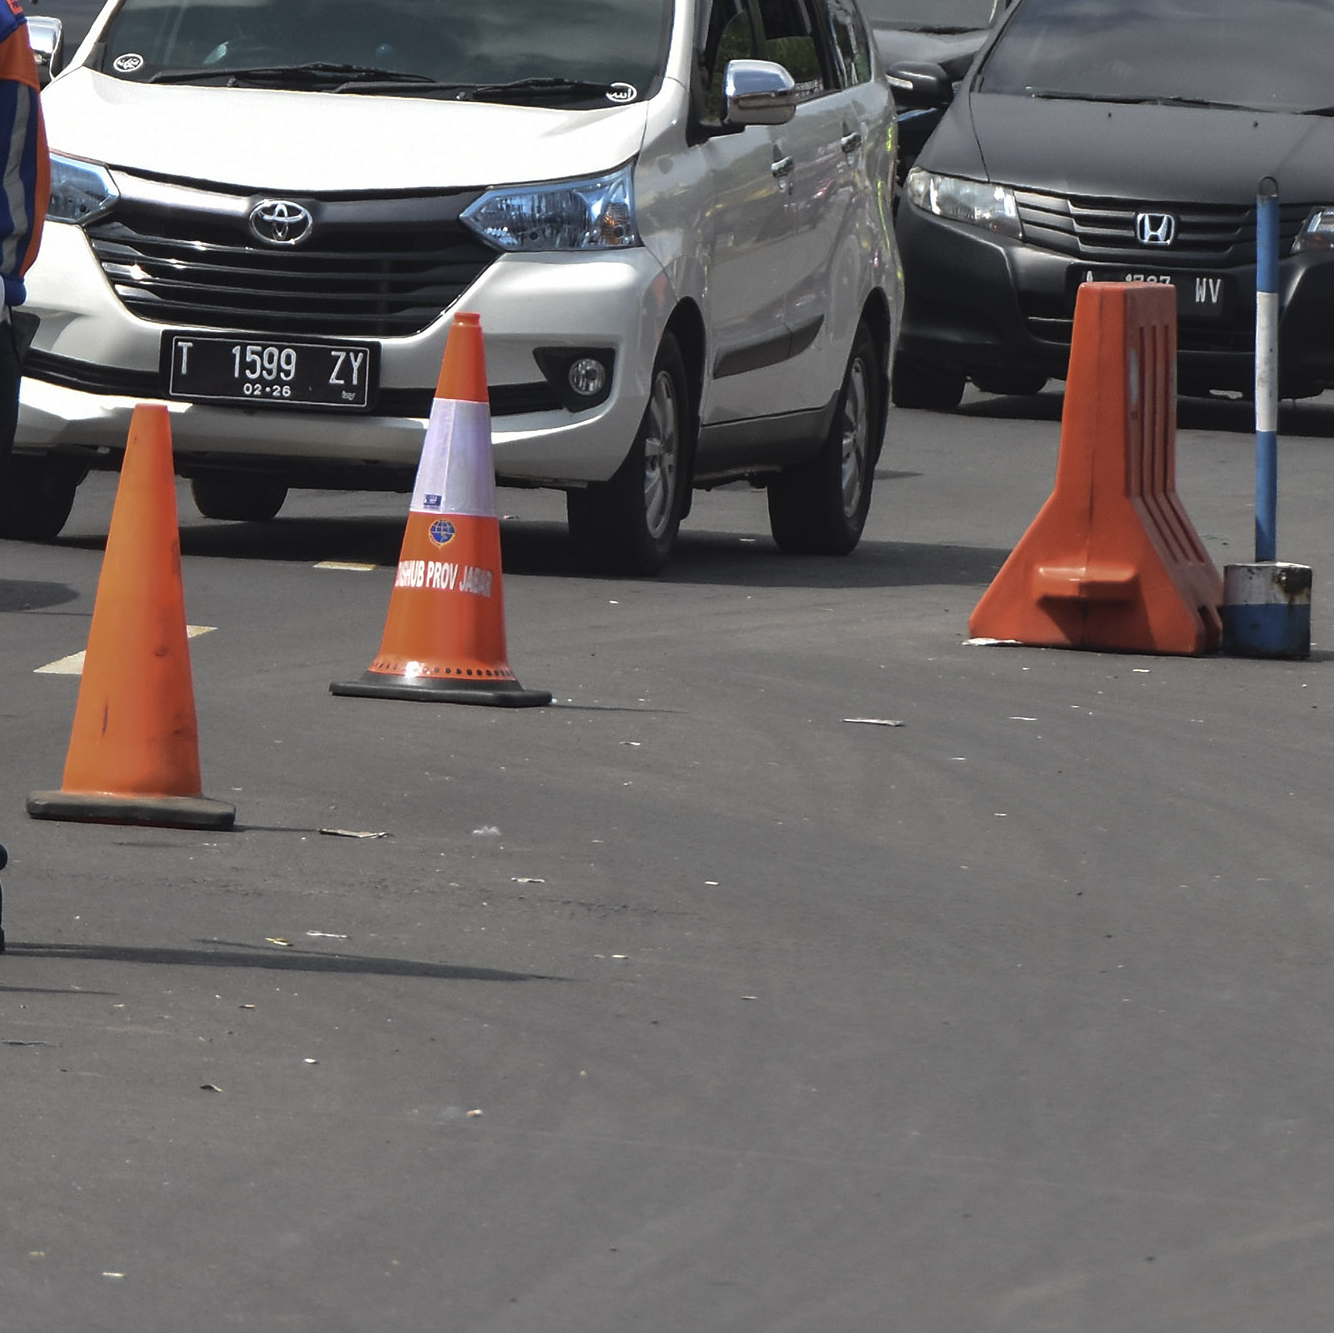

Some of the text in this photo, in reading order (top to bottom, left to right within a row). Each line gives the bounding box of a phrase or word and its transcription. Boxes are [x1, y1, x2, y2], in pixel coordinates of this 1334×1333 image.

[1194, 277, 1222, 303] WV
[177, 341, 364, 385] T 1599 ZY
[425, 560, 459, 590] PROV
